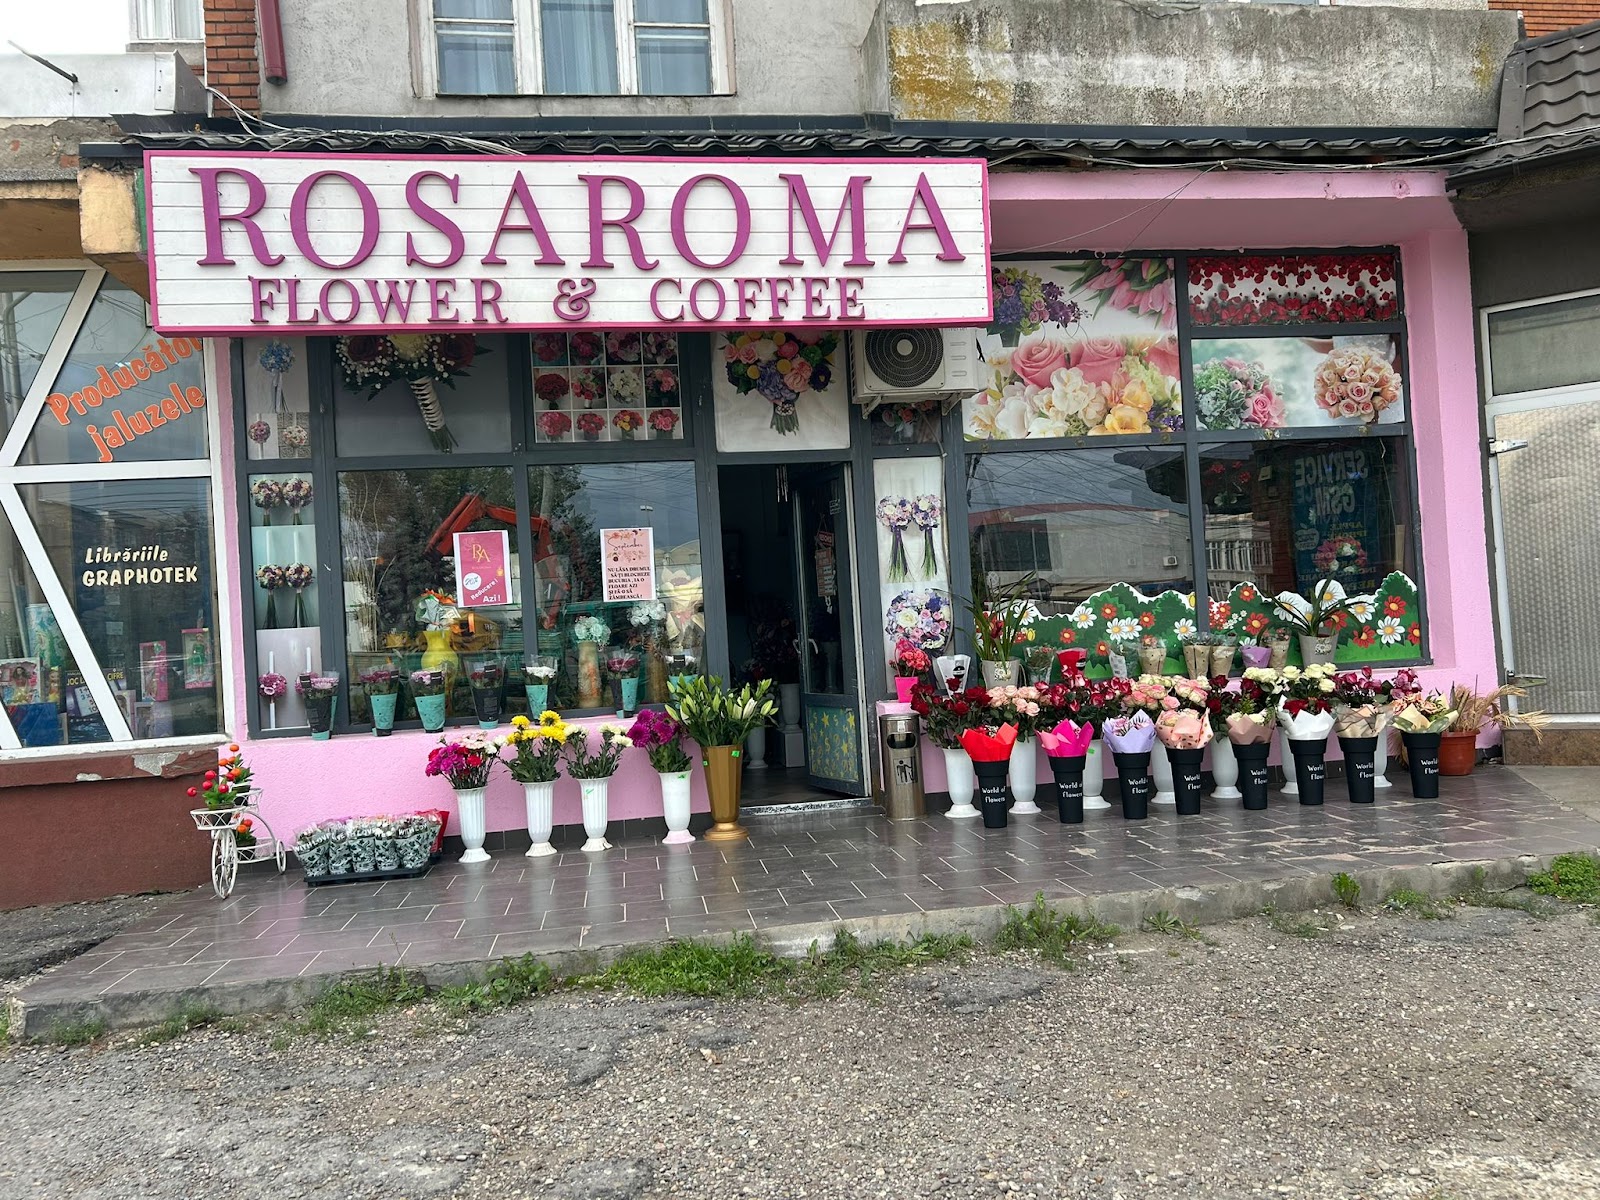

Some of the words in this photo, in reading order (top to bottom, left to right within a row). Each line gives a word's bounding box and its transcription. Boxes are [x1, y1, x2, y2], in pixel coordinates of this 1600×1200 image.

[188, 168, 965, 271] ROSAROMA
[249, 275, 509, 325] FLOWER
[553, 276, 599, 325] &
[650, 275, 867, 324] COFFEE
[86, 381, 206, 463] jaluzele
[84, 545, 169, 565] Librăriile
[82, 565, 198, 588] GRAPHOTEK
[483, 594, 497, 603] Azi
[107, 672, 124, 680] CIFRE
